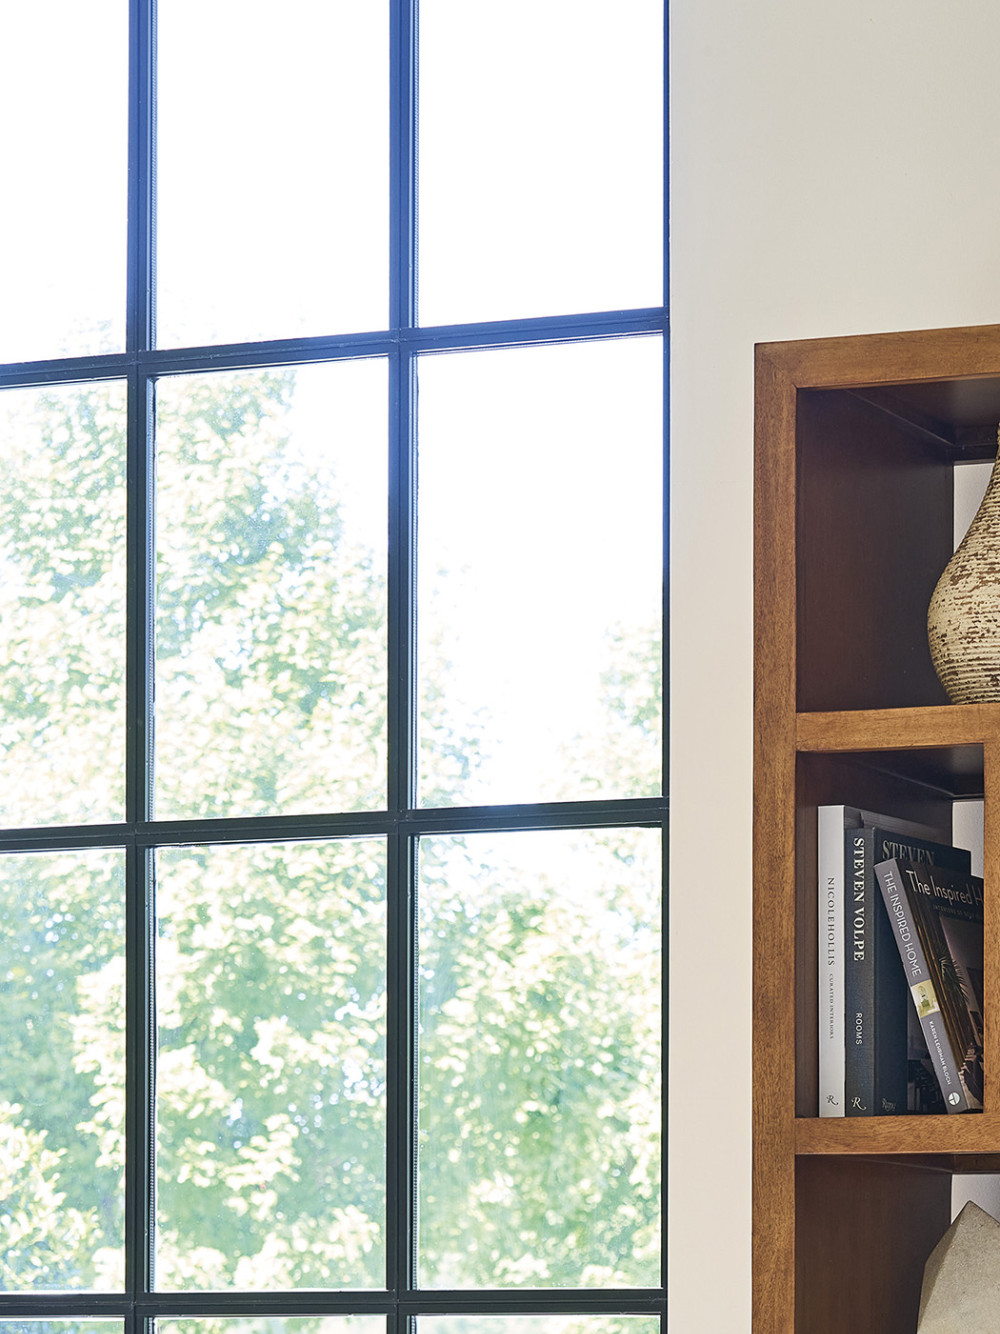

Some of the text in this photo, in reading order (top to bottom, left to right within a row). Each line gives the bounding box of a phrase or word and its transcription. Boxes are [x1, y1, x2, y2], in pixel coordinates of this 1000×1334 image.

[882, 840, 935, 866] STEVEN
[853, 837, 865, 961] STEVEN VOLPE
[905, 869, 931, 895] The
[930, 875, 973, 906] Inspired
[827, 877, 835, 966] NICOLEHOLLIS
[883, 870, 922, 977] THE INSPIRED HOME
[855, 1012, 863, 1045] ROOMS
